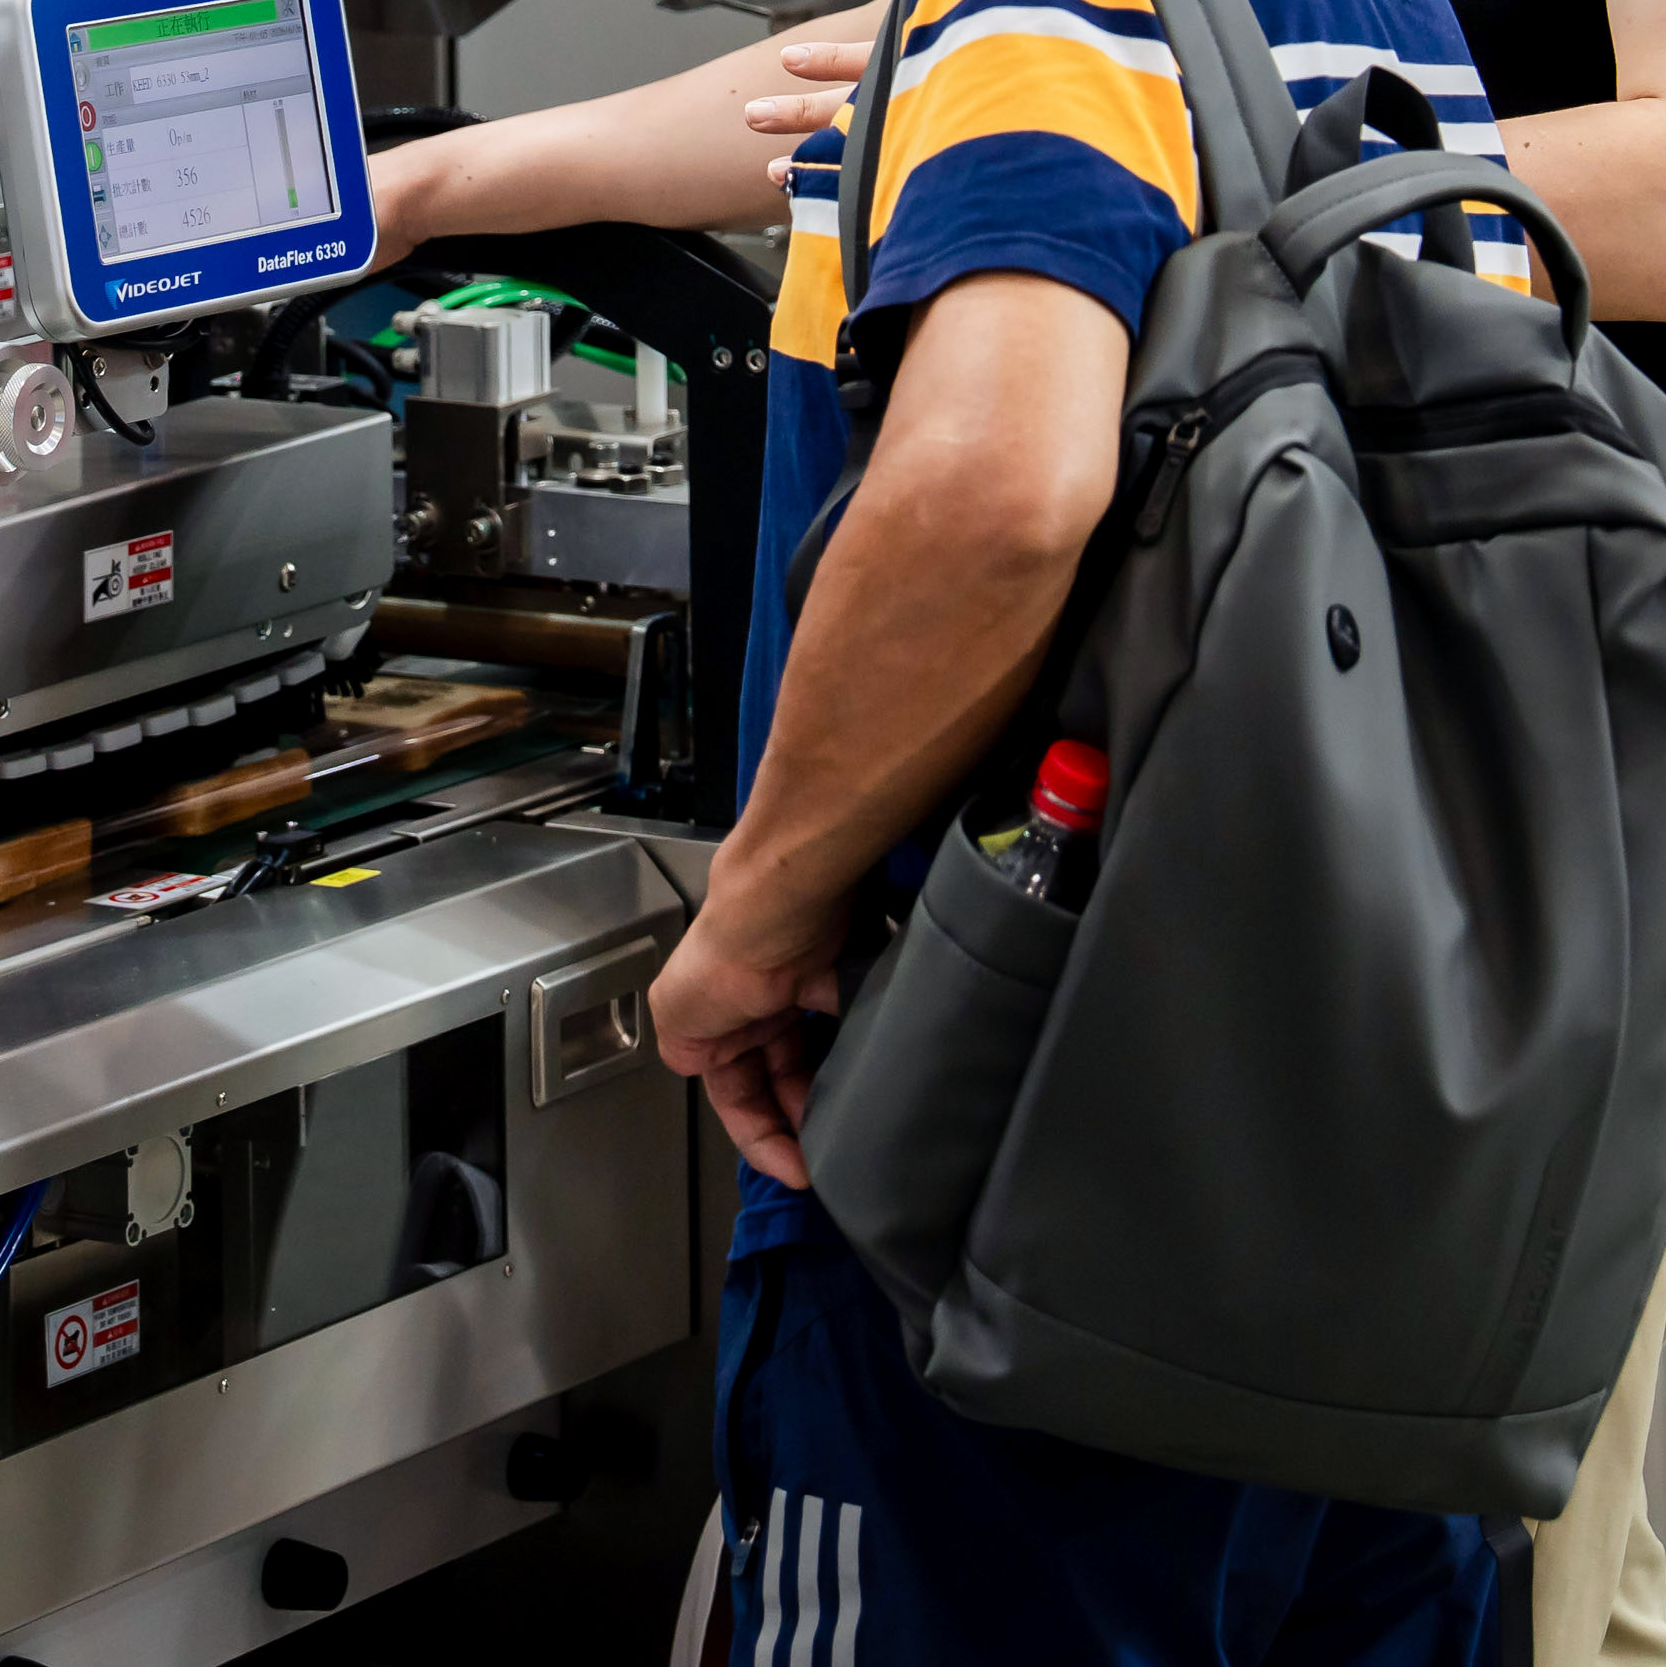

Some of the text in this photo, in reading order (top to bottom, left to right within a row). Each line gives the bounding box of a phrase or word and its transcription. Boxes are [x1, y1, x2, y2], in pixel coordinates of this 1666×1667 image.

[157, 11, 211, 38] 正在執行
[106, 81, 125, 98] 工作
[157, 70, 176, 88] 6330
[106, 137, 137, 157] 生產量
[176, 166, 198, 188] 356
[182, 206, 212, 228] 4526
[258, 241, 347, 274] DataFlex 6330
[116, 271, 203, 303] VIDEOJET
